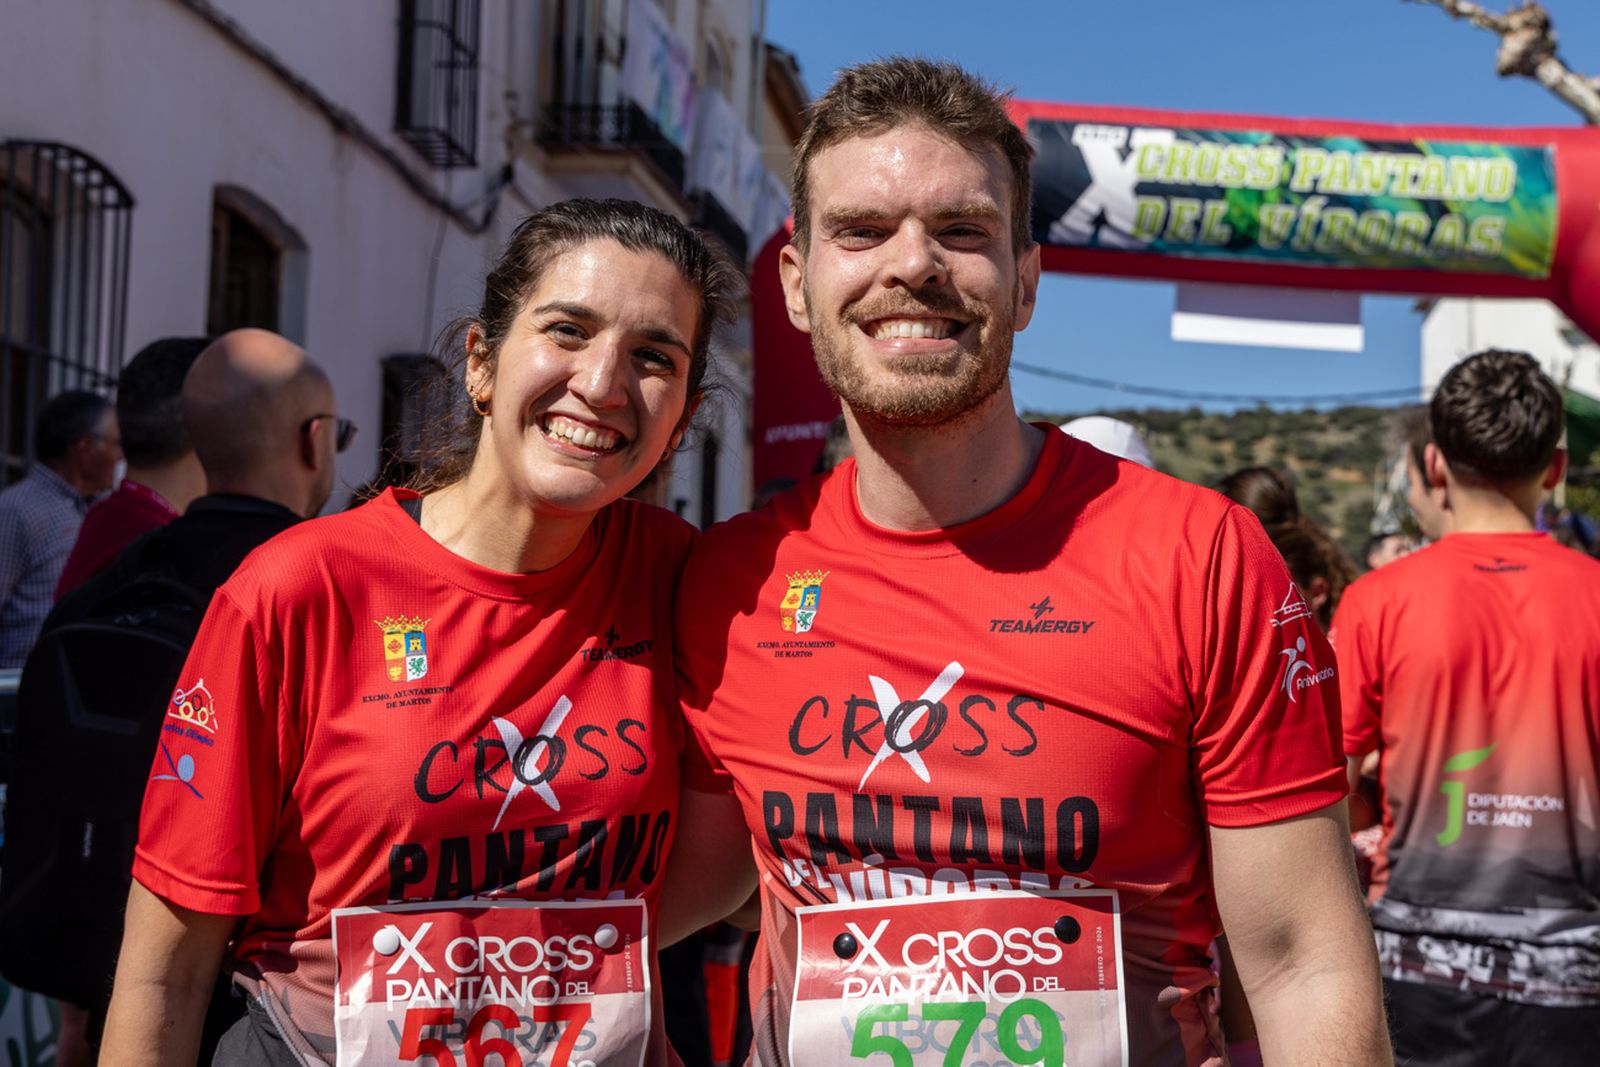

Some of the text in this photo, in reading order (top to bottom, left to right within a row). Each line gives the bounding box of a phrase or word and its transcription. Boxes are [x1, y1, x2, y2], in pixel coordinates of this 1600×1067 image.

[1135, 140, 1283, 191] CROSS
[1289, 148, 1517, 203] PANTANO
[1132, 195, 1232, 245] DEL
[580, 639, 654, 662] TEAMERGY
[783, 641, 836, 649] AYUNTAMIENTO
[989, 619, 1096, 634] TEAMERGY
[774, 650, 813, 658] DE MARTOS
[393, 686, 455, 699] AYUNTAMIENTO
[399, 697, 432, 708] MARTOS
[788, 694, 1045, 759] CROSS
[414, 718, 647, 803] CROSS
[763, 790, 1100, 874] PANTANO
[1467, 811, 1488, 826] DE
[387, 809, 671, 900] PANTANO
[384, 922, 596, 975] X CROSS
[844, 919, 1063, 976] X CROSS
[385, 975, 596, 1012] PANTANO DEL
[841, 969, 1066, 1006] PANTANO DEL
[398, 1003, 592, 1067] 567
[851, 998, 1065, 1067] 579
